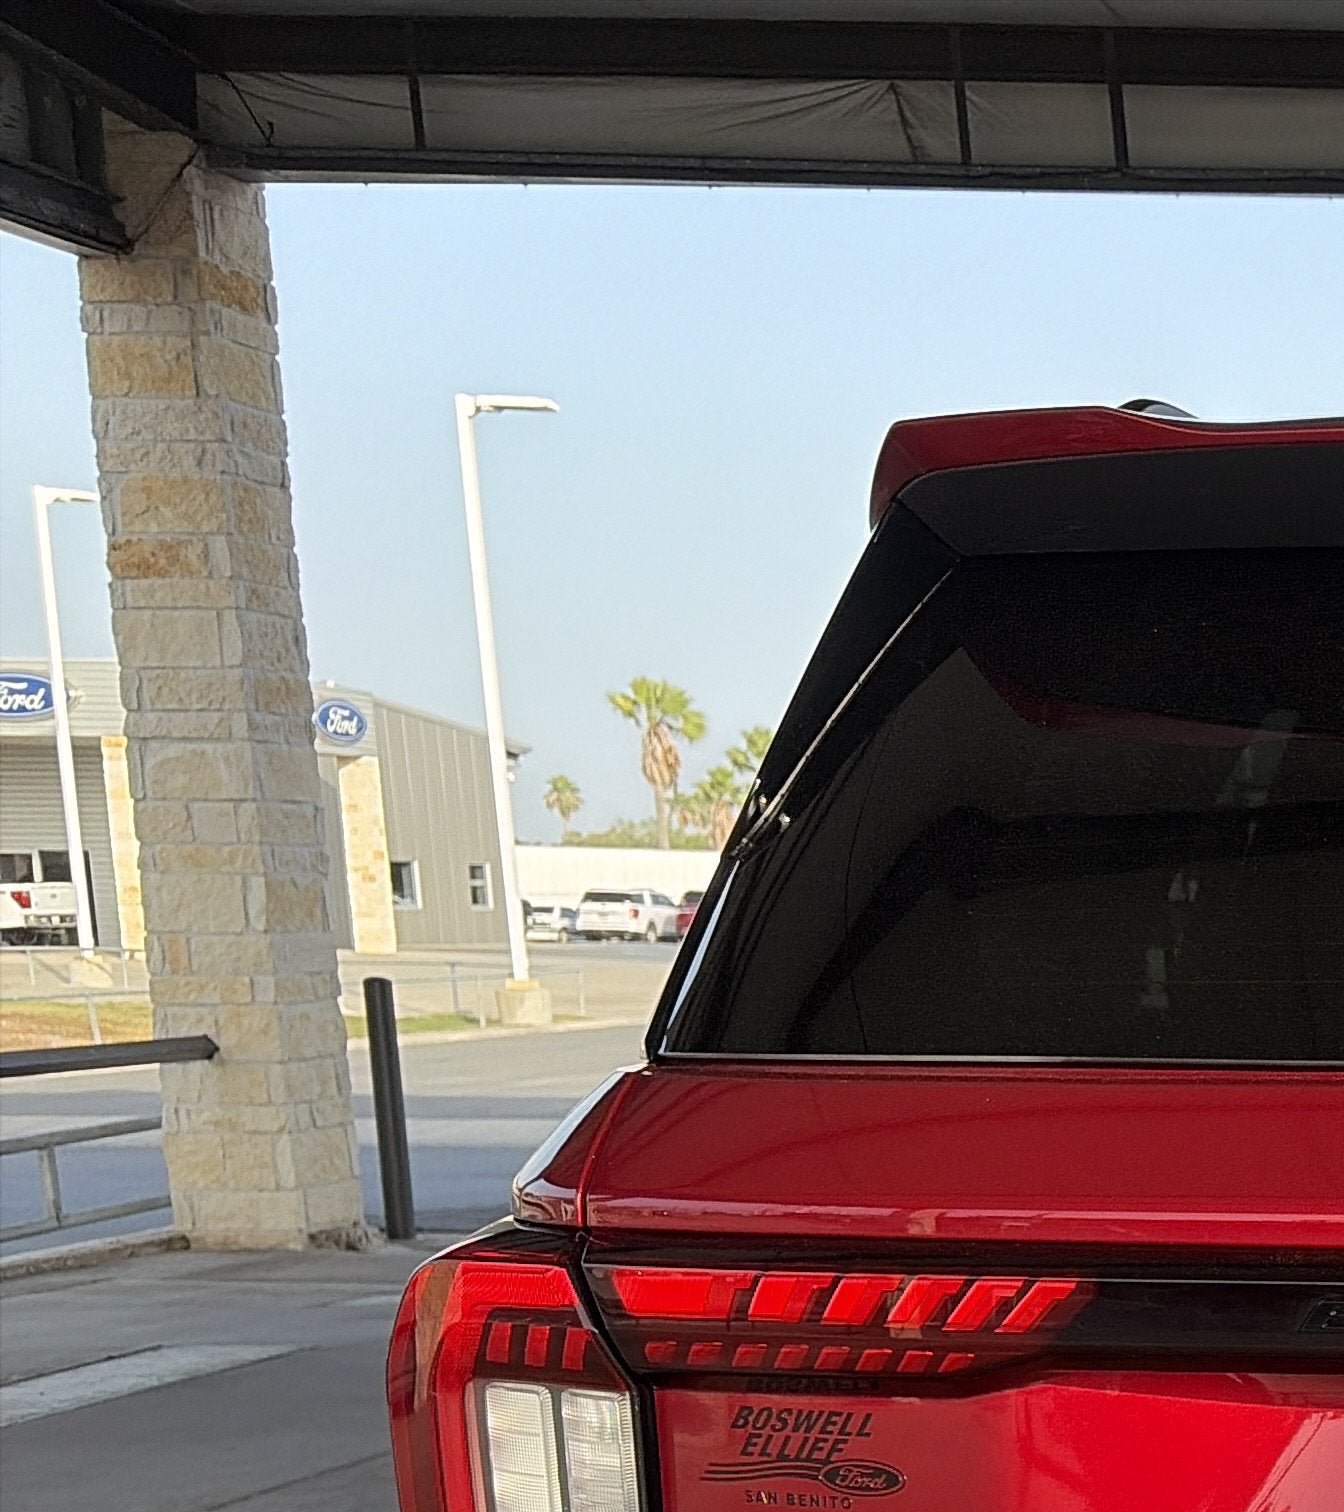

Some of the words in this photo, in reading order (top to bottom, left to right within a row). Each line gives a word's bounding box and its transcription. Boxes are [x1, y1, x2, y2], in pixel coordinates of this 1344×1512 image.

[326, 706, 358, 735] Ford
[730, 1405, 873, 1438] BOSWELL
[740, 1432, 850, 1464] ELLIFF
[835, 1466, 888, 1489] Ford
[745, 1489, 778, 1505] SAN
[786, 1491, 853, 1510] BENITO
